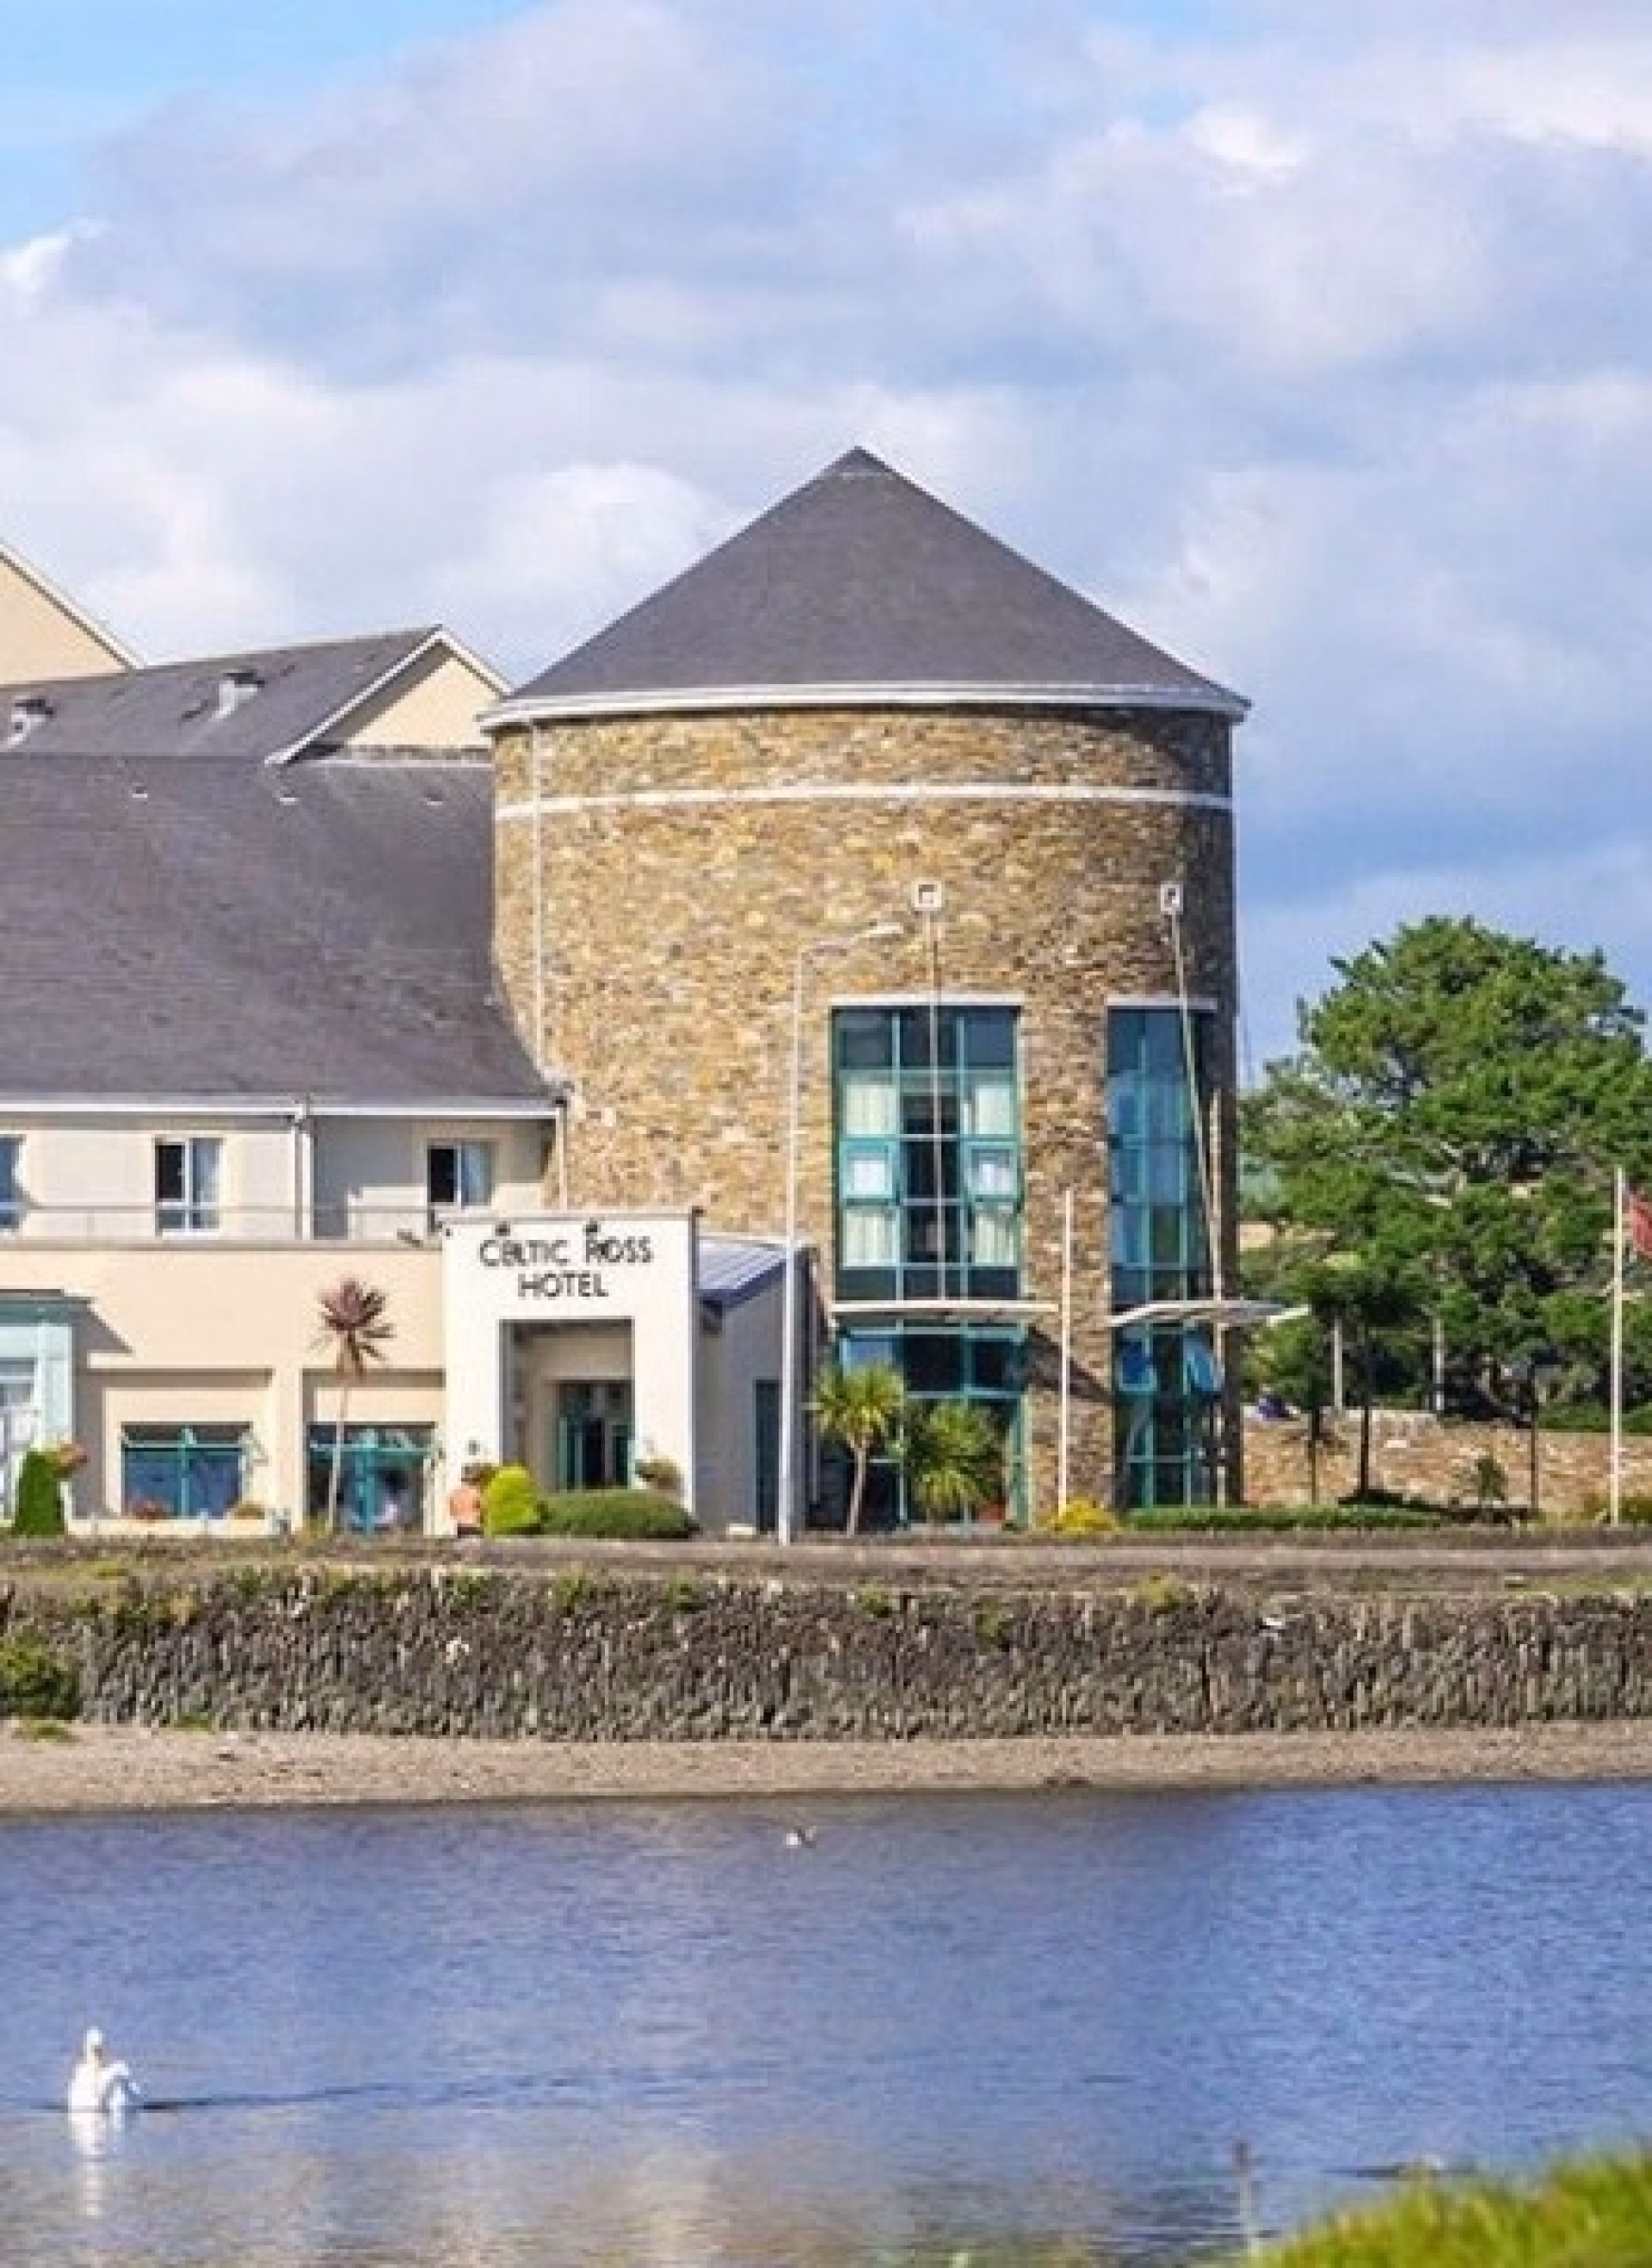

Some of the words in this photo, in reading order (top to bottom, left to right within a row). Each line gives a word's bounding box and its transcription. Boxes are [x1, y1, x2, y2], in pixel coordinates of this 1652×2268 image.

[478, 1238, 570, 1267] CELTIC
[584, 1236, 654, 1264] ROSS
[517, 1271, 609, 1298] HOTEL
